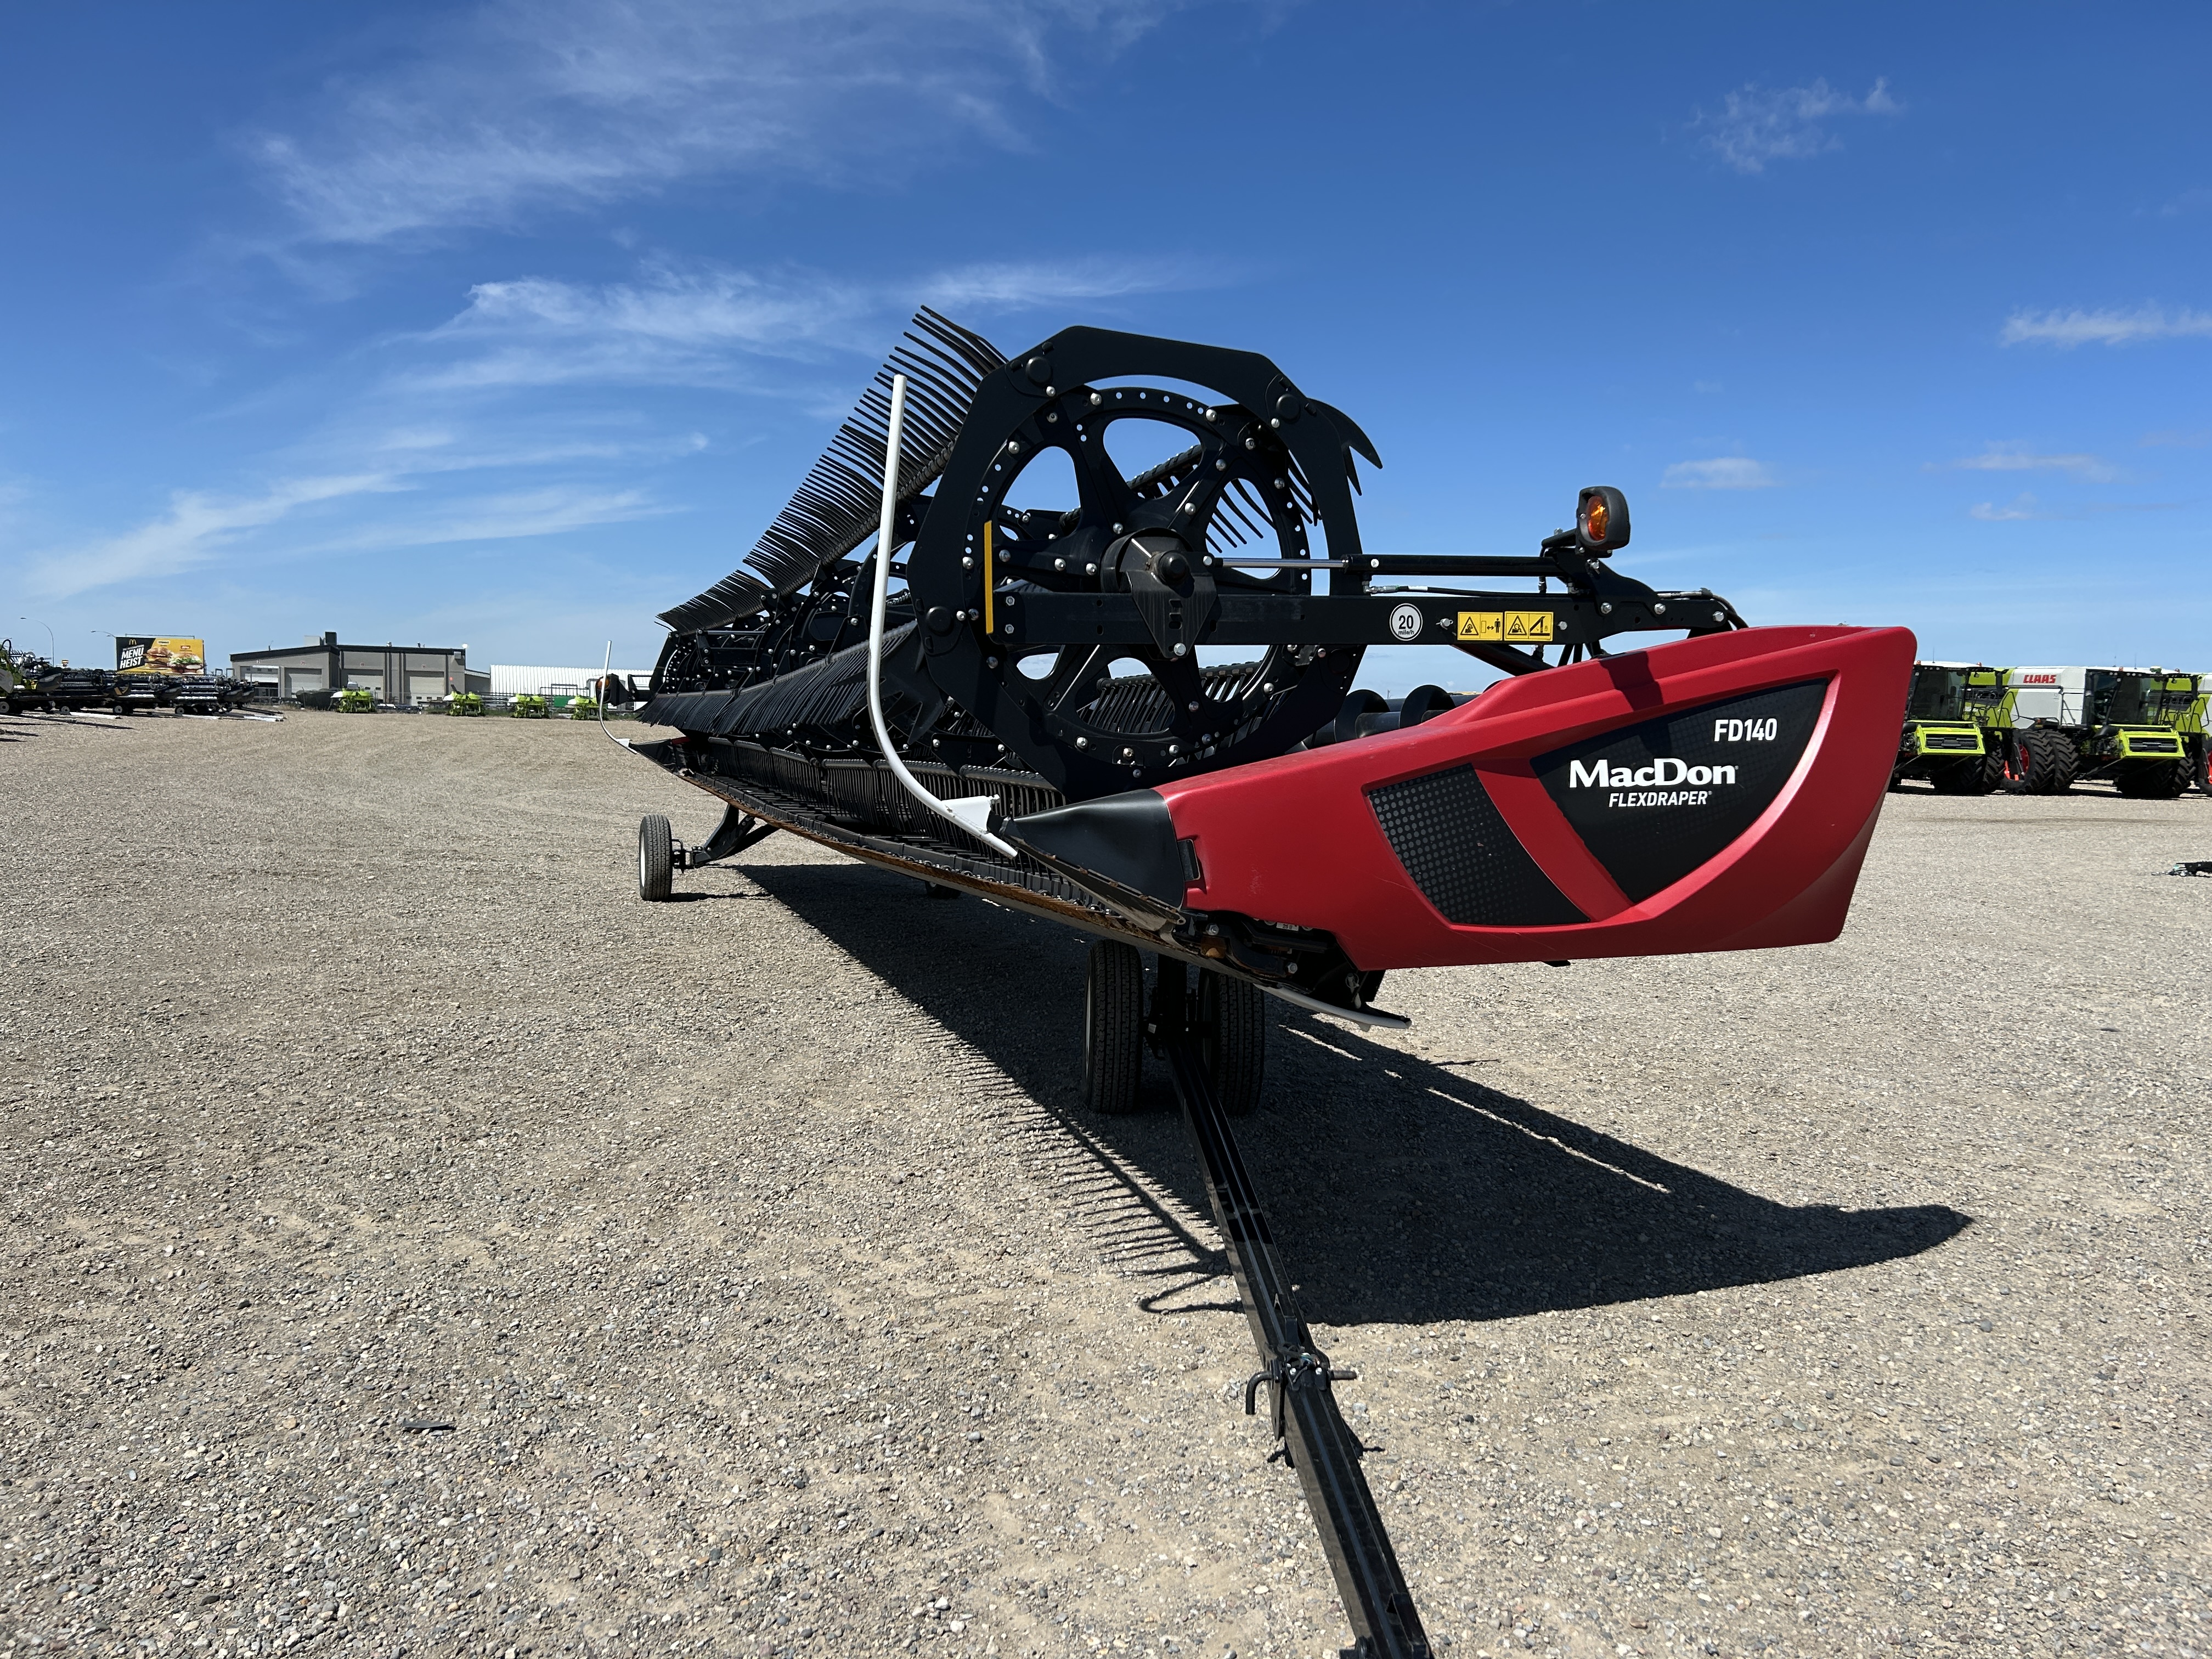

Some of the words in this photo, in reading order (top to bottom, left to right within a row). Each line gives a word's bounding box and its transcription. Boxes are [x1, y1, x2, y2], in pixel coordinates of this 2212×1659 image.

[1398, 614, 1414, 629] 20
[121, 647, 144, 660] MENU
[120, 656, 143, 669] HEIST
[2023, 674, 2057, 684] CLAAS
[1713, 718, 1778, 742] FD140
[1568, 758, 1736, 788] MacDon
[1608, 791, 1709, 808] FLEXDRAPER
